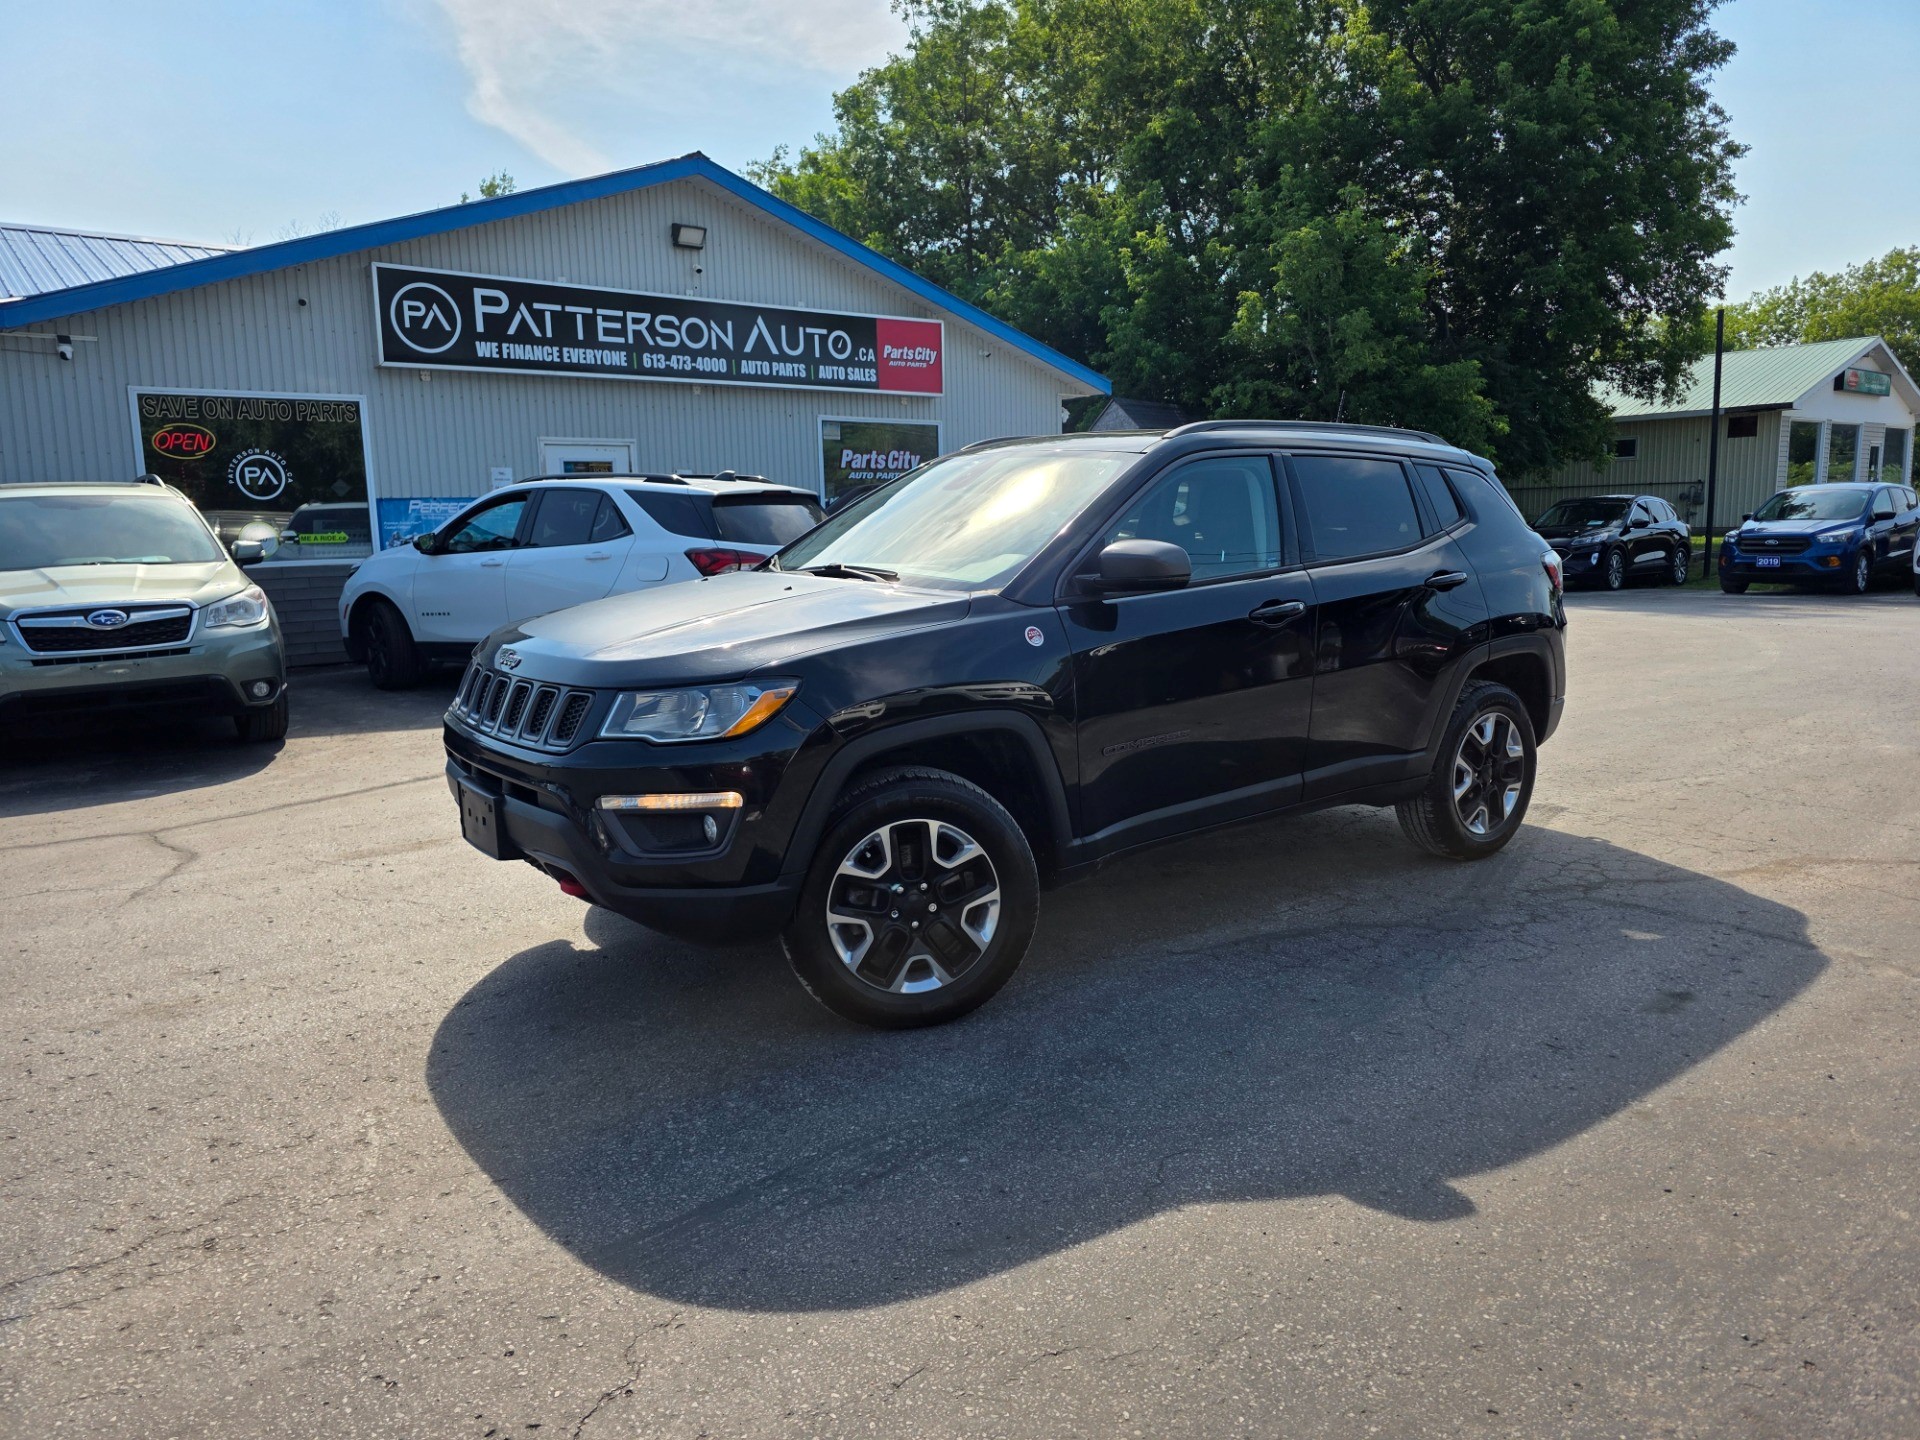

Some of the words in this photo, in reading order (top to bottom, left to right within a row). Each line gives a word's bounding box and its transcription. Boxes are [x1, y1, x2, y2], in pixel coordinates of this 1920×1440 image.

[403, 300, 452, 331] PA
[473, 287, 734, 351] PATTERSON
[744, 315, 852, 360] AUTO
[475, 341, 499, 358] WE
[502, 343, 560, 362] FINANCE
[563, 347, 627, 367] EVERYONE
[643, 353, 727, 373] 613-473-4000
[741, 360, 770, 376] AUTO
[772, 362, 806, 378] PARTS
[818, 365, 846, 380] AUTO
[847, 367, 877, 382] SALES
[883, 344, 937, 364] PartsCity
[906, 361, 927, 369] PARTS
[143, 396, 199, 419] SAVE
[202, 398, 233, 420] ON
[237, 400, 292, 421] AUTO
[296, 401, 358, 423] PARTS
[154, 432, 211, 451] OPEN
[228, 448, 260, 485] PATTERSON
[264, 449, 287, 466] AUTO
[244, 467, 279, 486] PA
[849, 471, 874, 479] AUTO
[876, 472, 901, 480] PART
[408, 499, 468, 514] PERFEC
